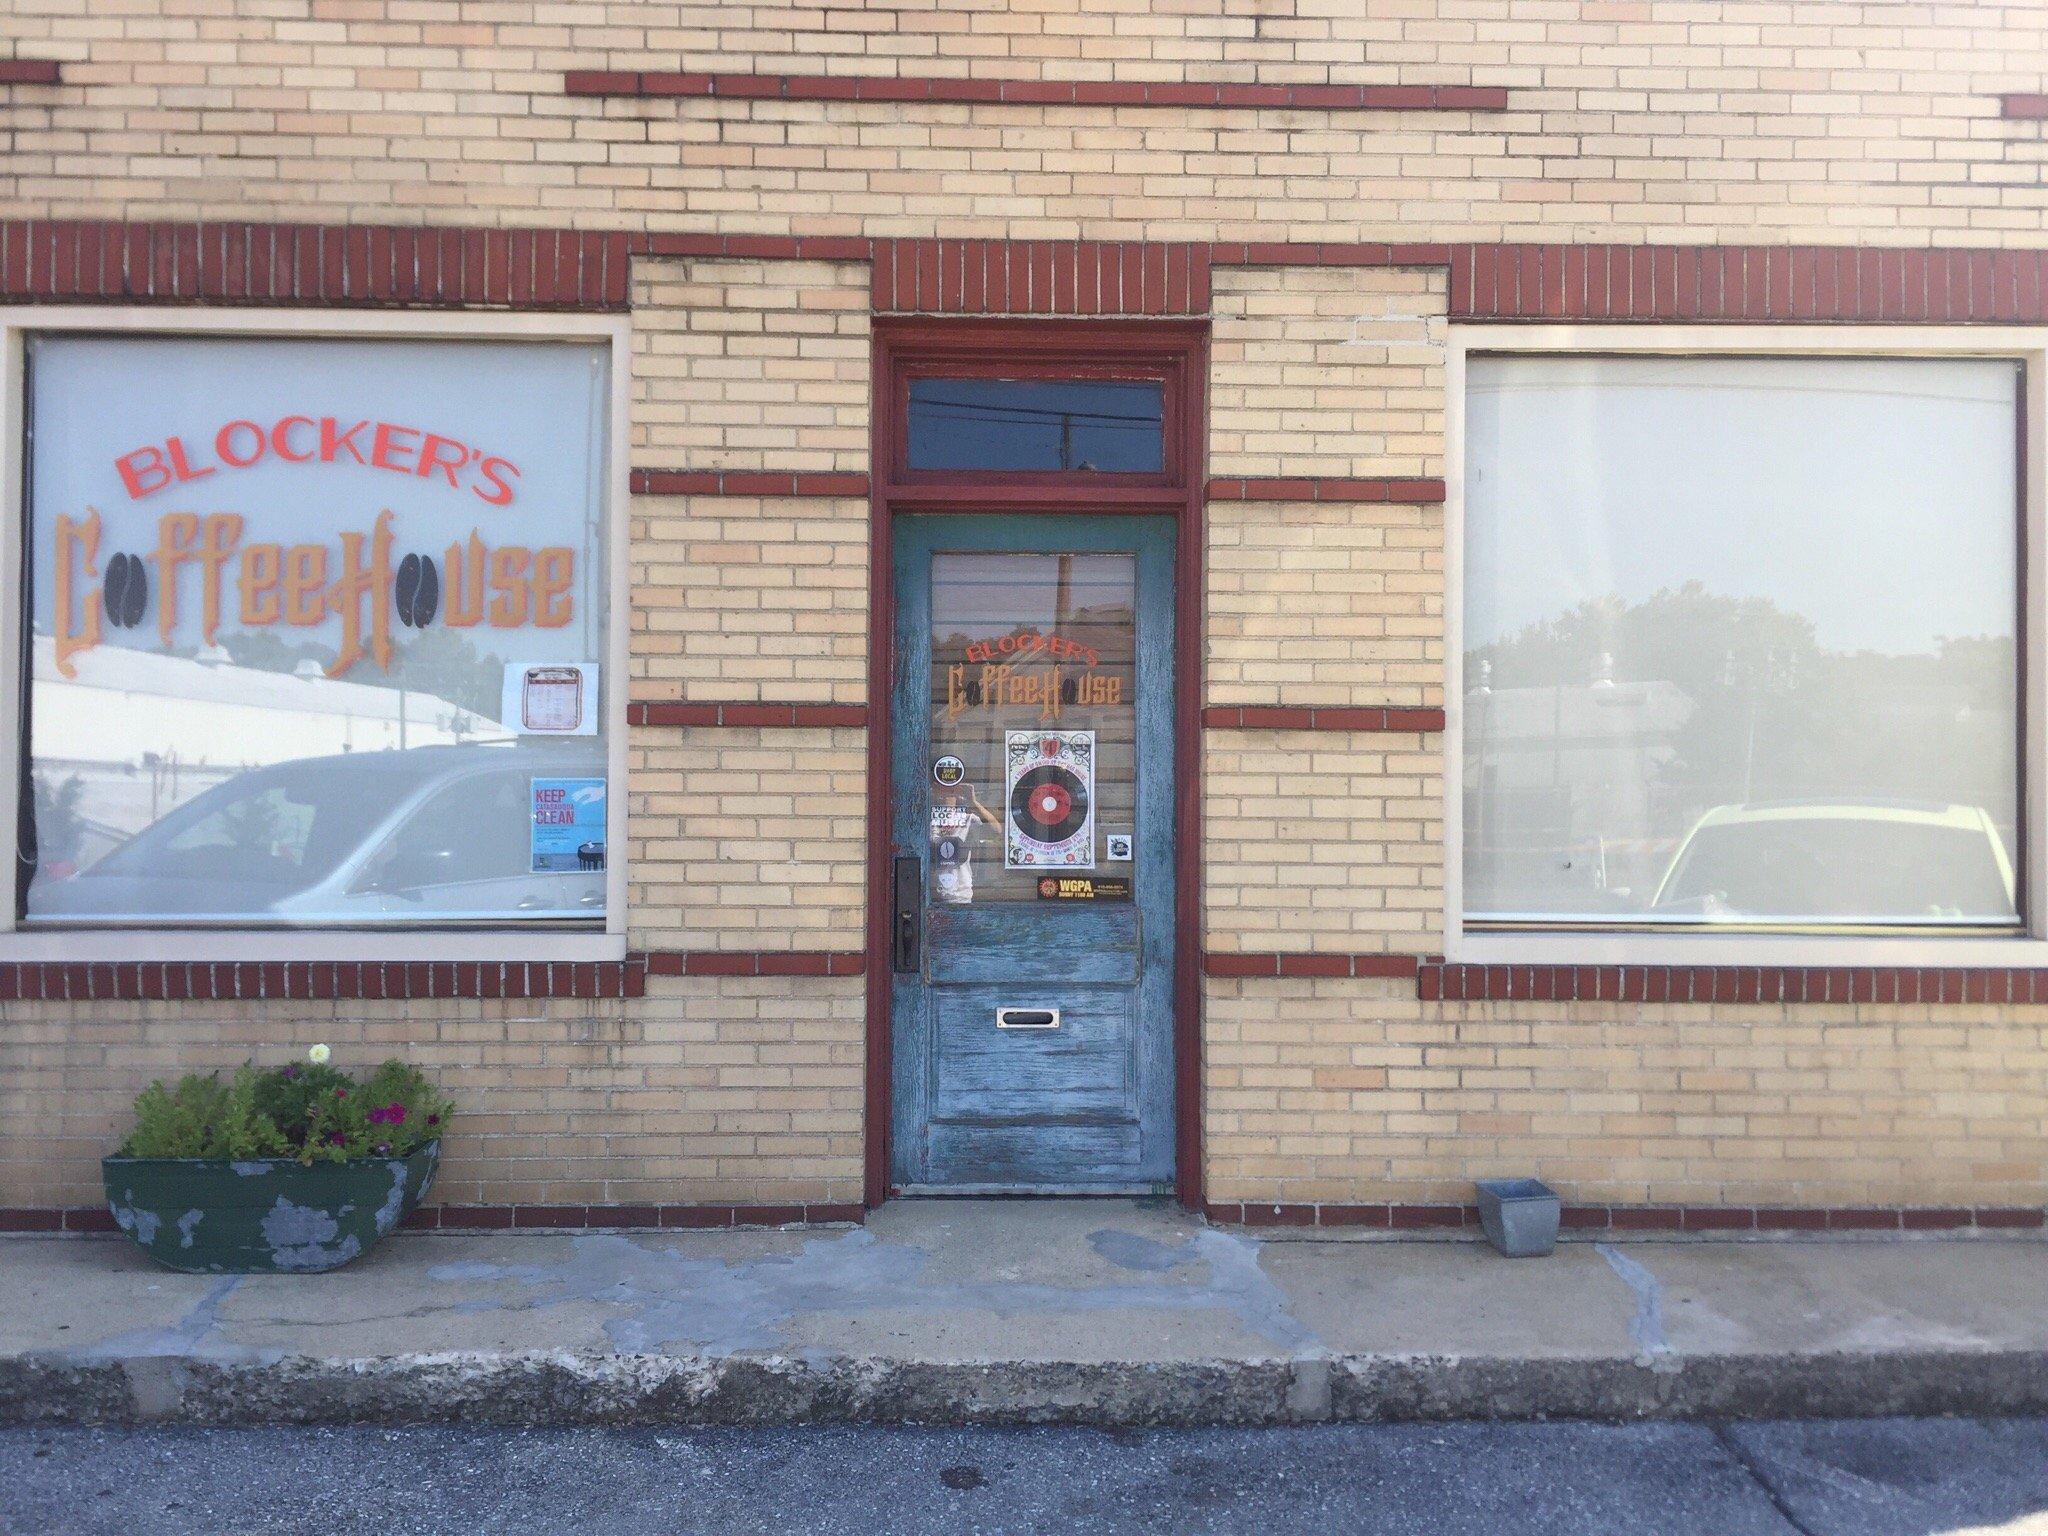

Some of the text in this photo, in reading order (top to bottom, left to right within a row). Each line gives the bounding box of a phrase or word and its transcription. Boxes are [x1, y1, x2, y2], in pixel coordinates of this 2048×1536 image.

[114, 415, 521, 506] BLOCKER'S
[966, 633, 1101, 668] BLOCKER'S
[535, 789, 566, 803] KEEP
[535, 810, 575, 825] CLEAN
[931, 819, 967, 827] MUSIC
[1059, 879, 1093, 892] WGPA
